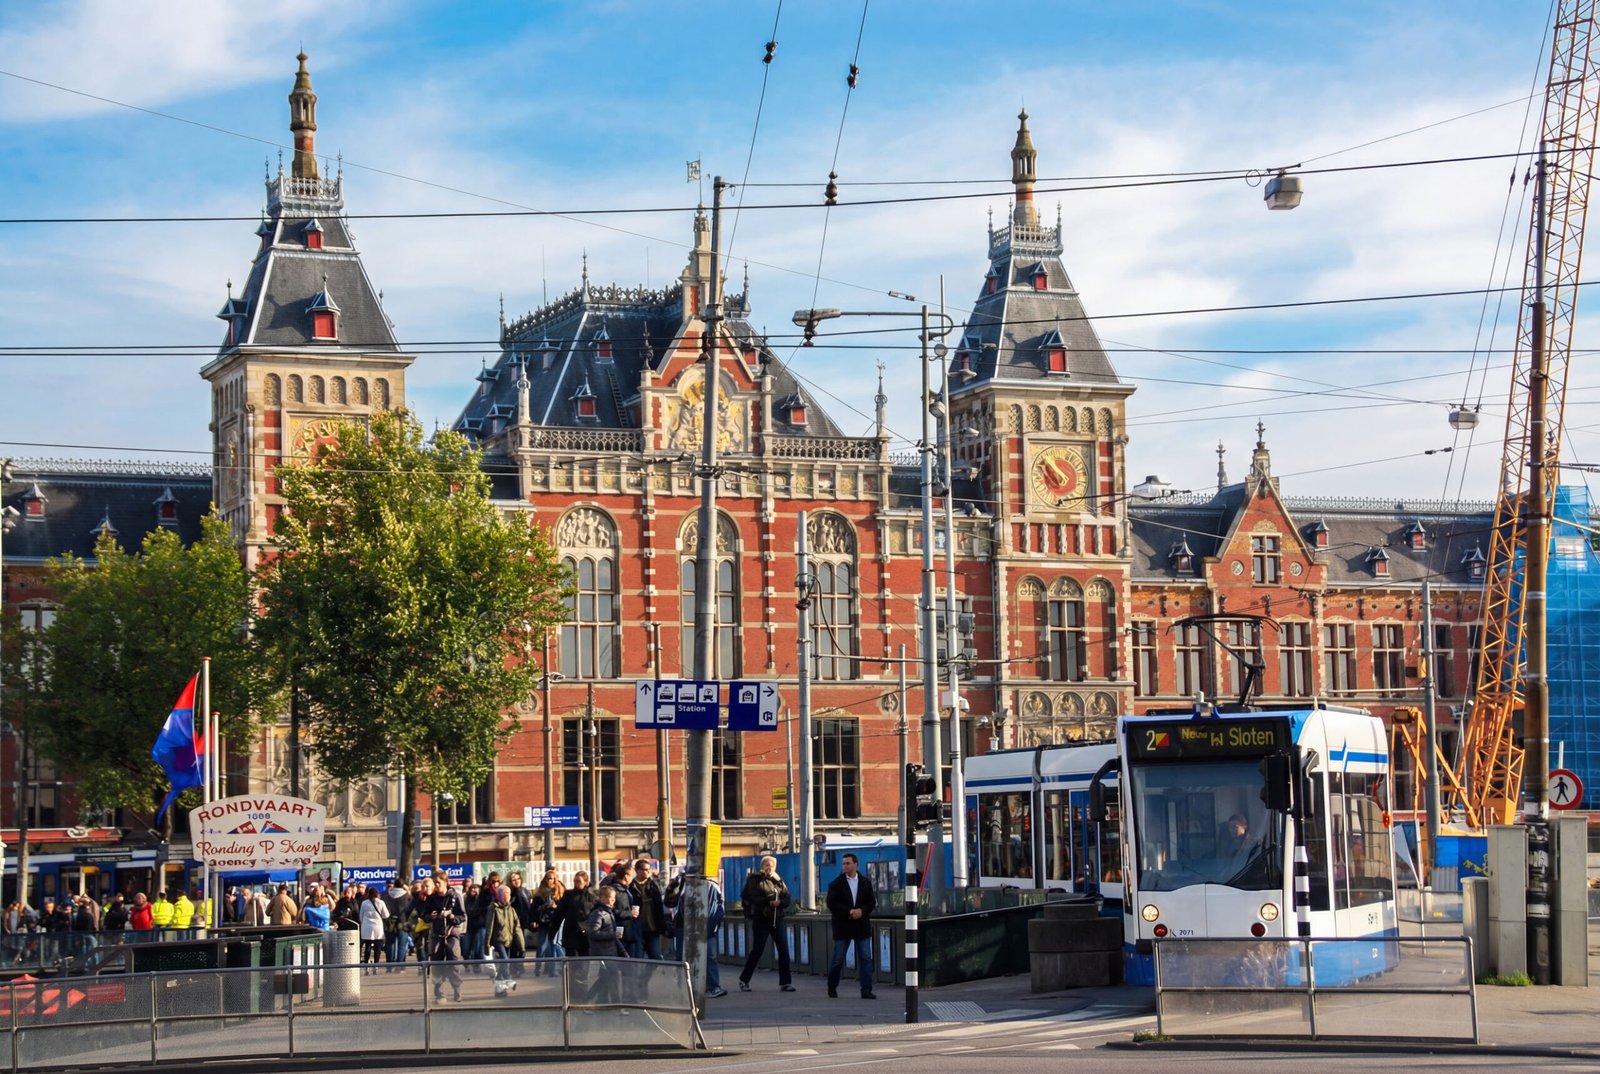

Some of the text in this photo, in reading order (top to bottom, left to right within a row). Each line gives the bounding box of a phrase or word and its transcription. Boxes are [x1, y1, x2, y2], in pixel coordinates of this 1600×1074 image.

[678, 704, 706, 712] Station
[1146, 729, 1156, 750] 2
[1229, 727, 1274, 746] Sloten
[197, 799, 316, 823] RONDVAART
